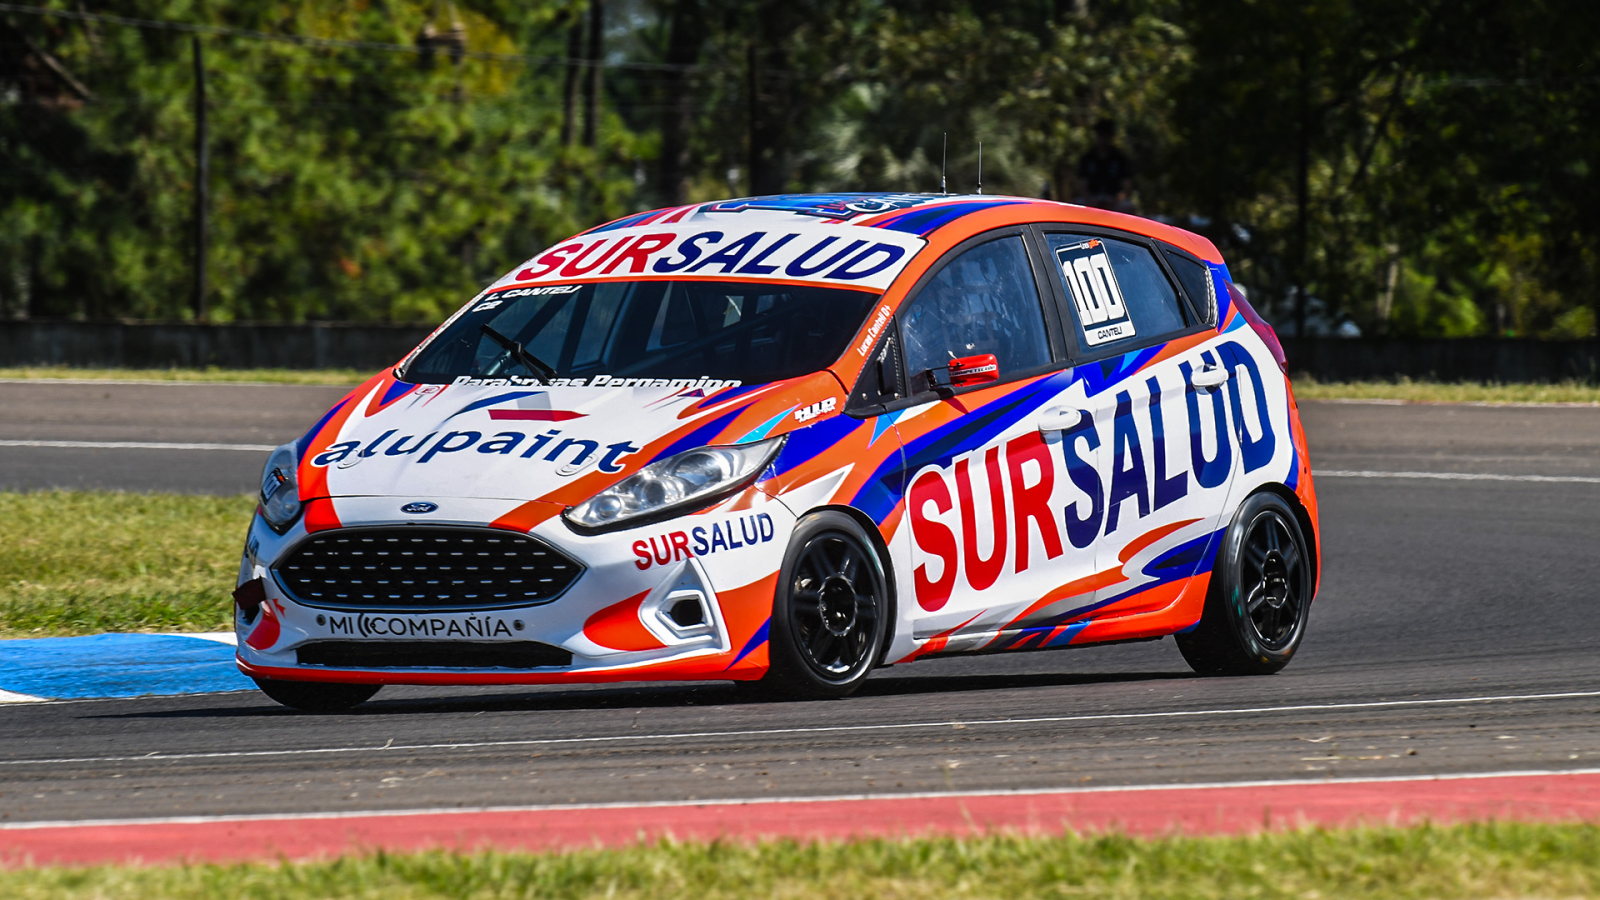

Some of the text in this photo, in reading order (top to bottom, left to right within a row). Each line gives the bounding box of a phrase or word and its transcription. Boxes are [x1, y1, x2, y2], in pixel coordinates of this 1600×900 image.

[515, 231, 906, 282] SURSALUD
[501, 285, 583, 299] CANTELI
[1063, 252, 1126, 326] 100
[857, 334, 874, 357] Lucas
[1097, 326, 1123, 339] CANTELI
[312, 429, 640, 473] alupaint
[909, 340, 1276, 612] SURSALUD
[632, 513, 774, 571] SURSALUD
[329, 614, 513, 637] MI COMPAÑÍA
